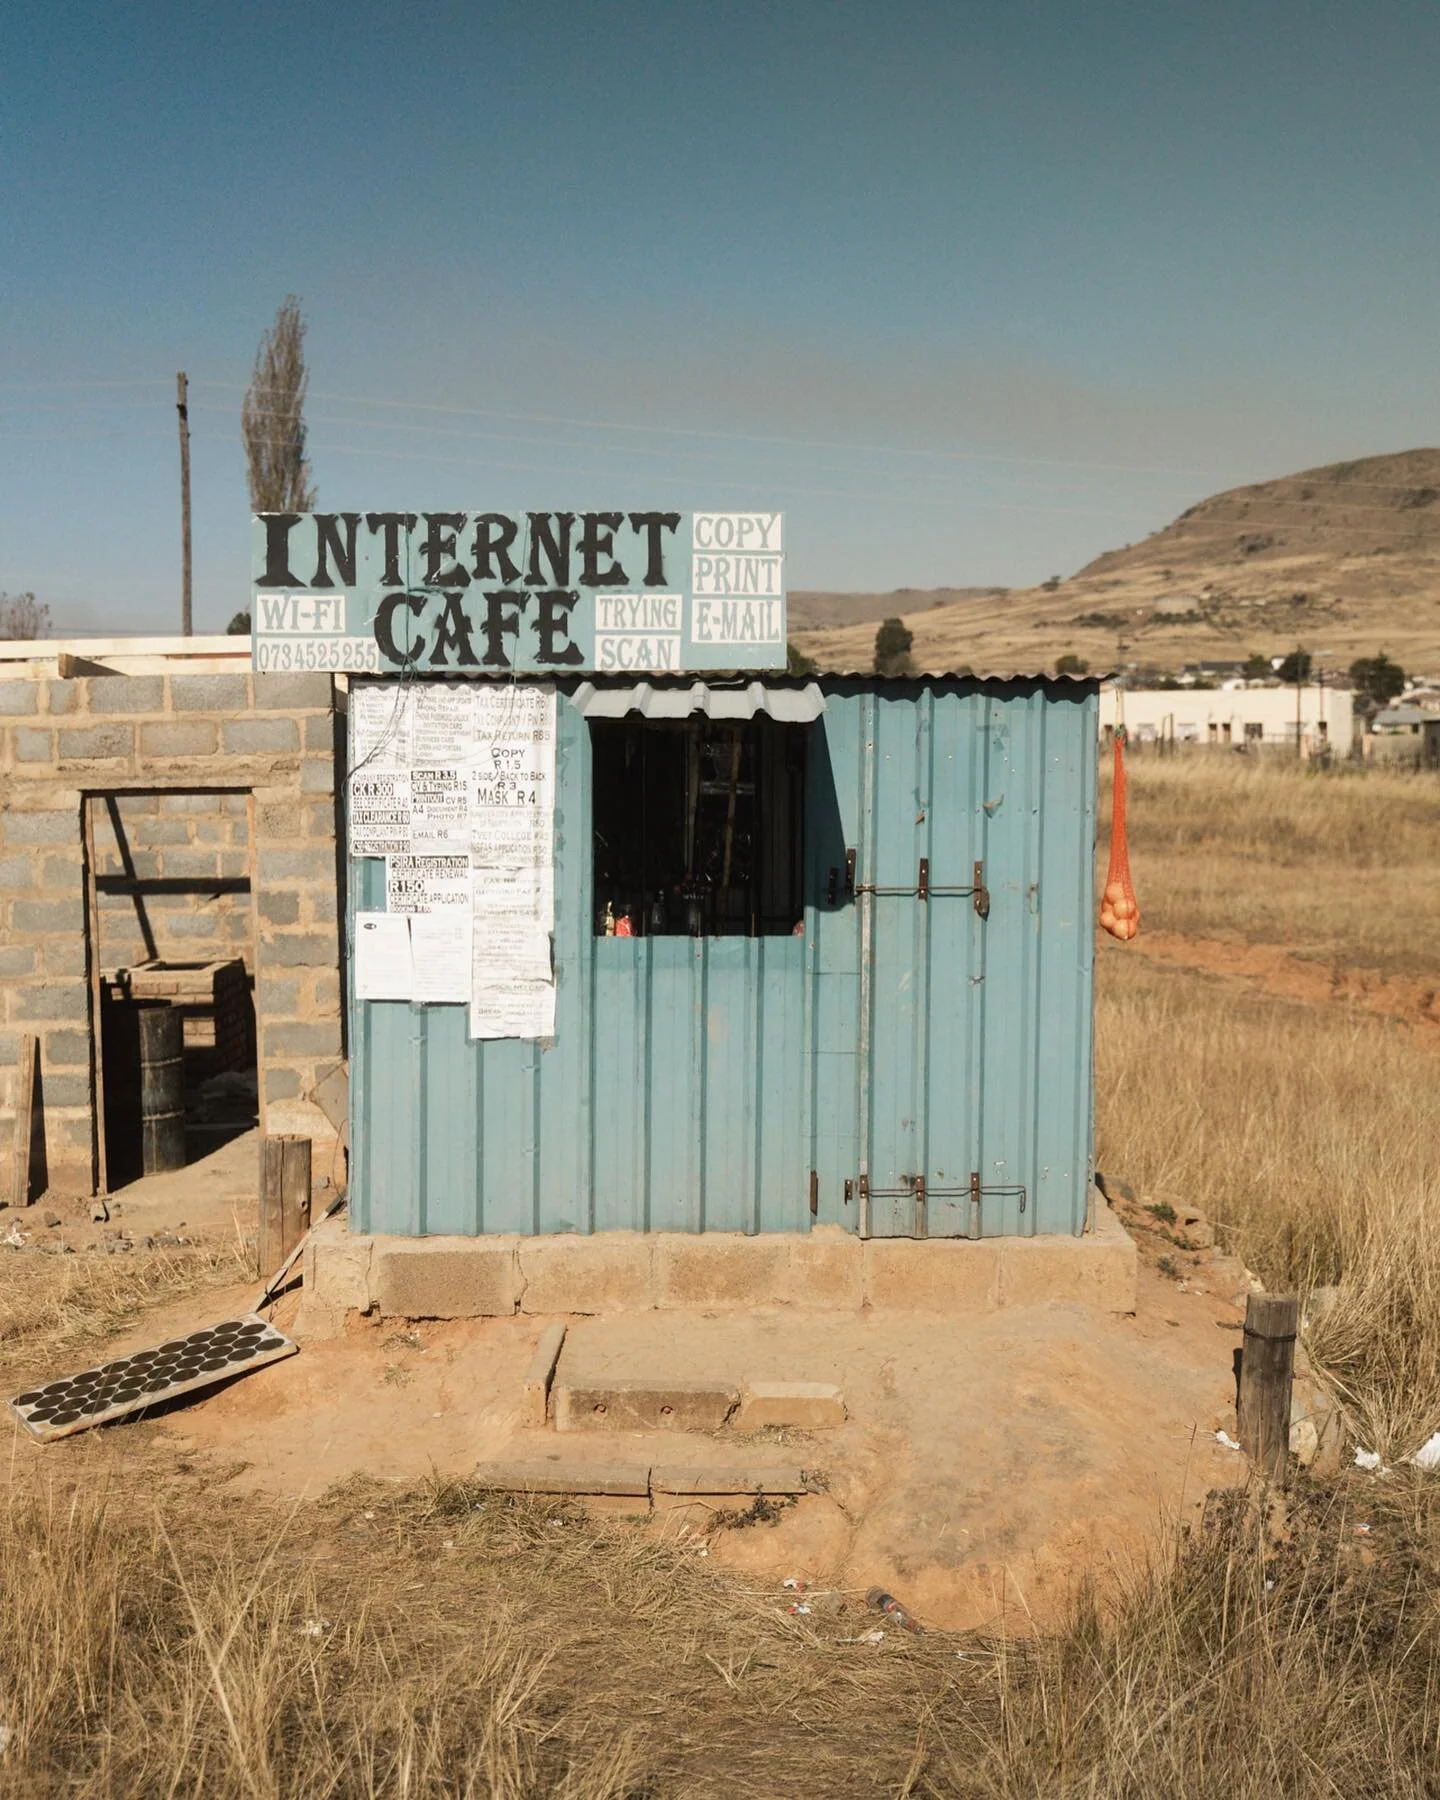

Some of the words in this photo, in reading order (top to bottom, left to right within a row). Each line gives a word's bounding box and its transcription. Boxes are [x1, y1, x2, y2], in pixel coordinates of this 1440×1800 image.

[695, 514, 777, 548] COPY
[254, 512, 682, 588] INTERNET
[696, 555, 781, 593] PRINT
[260, 598, 343, 630] WI-FI
[374, 590, 585, 666] CAFE
[600, 597, 677, 629] TRYING
[696, 601, 780, 641] E-MAIL
[259, 640, 377, 670] 0734525255
[600, 637, 674, 670] SCAN
[491, 748, 525, 758] COPY
[412, 805, 424, 814] A4
[478, 788, 508, 804] MASK
[412, 830, 436, 840] EMAIL
[390, 856, 414, 868] PSIRA
[416, 856, 468, 868] REGISTRATION
[392, 869, 434, 879] CERTIFICATE
[436, 869, 468, 879] RENEWAL
[390, 893, 428, 904] CERTIFICATE
[430, 893, 469, 904] APPLICATION
